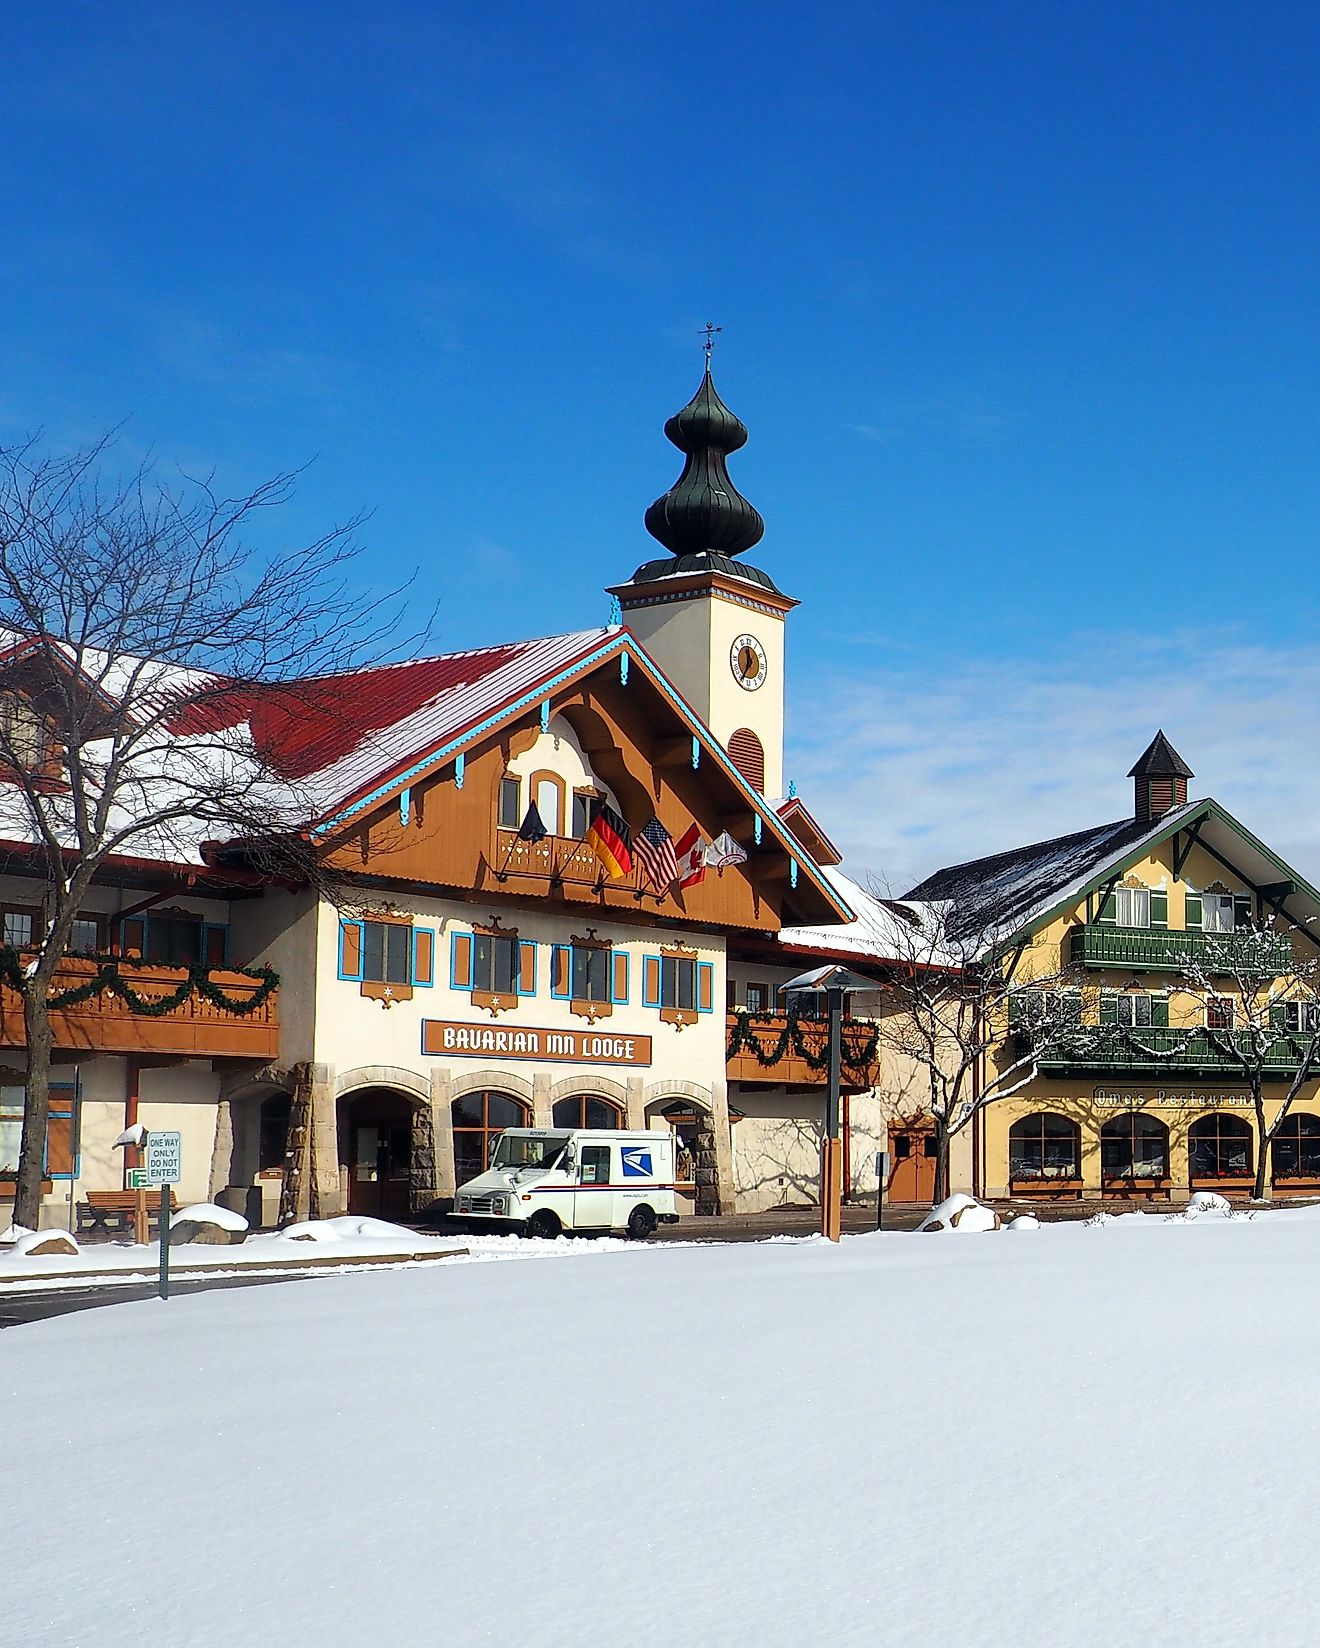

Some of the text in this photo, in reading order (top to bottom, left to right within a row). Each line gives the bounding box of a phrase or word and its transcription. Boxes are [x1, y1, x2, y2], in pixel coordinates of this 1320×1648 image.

[443, 1027, 636, 1060] BAVARIAN INN LODGE
[1098, 1089, 1255, 1106] Oma's Restaurant
[151, 1139, 179, 1147] ONE WAY
[163, 1159, 178, 1167] NOT
[151, 1169, 177, 1177] ENTER
